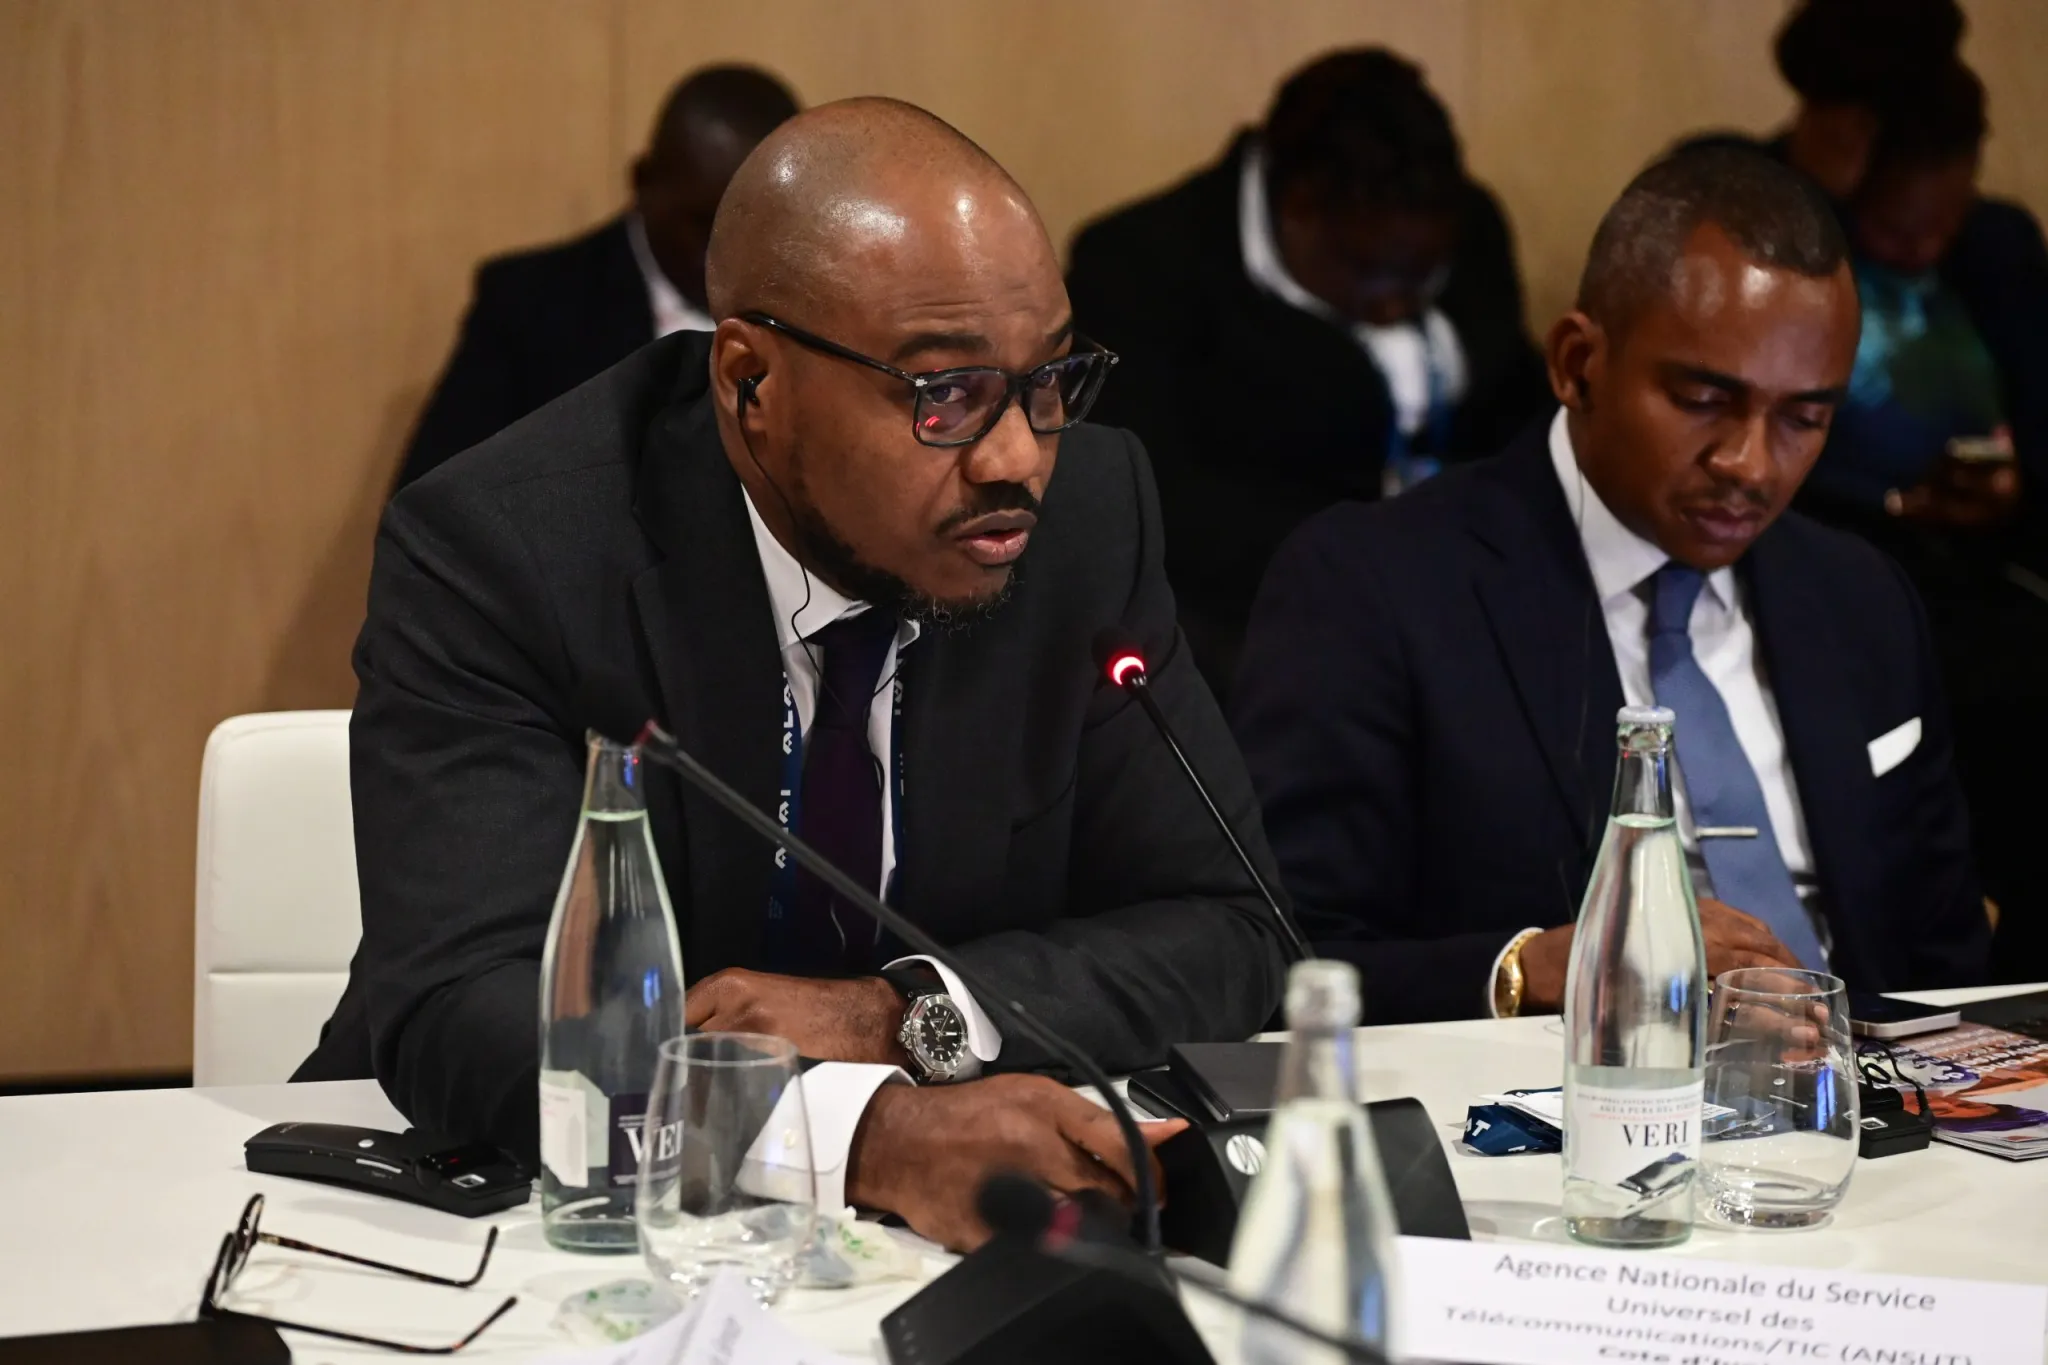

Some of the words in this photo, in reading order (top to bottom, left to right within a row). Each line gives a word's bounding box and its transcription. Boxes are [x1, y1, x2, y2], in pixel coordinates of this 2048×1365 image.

[1494, 1253, 1607, 1283] Agence
[1617, 1264, 1767, 1295] Nationale
[1776, 1278, 1816, 1301] du
[1825, 1281, 1936, 1311] Service
[1606, 1296, 1752, 1326] Universel
[1760, 1310, 1815, 1332] des
